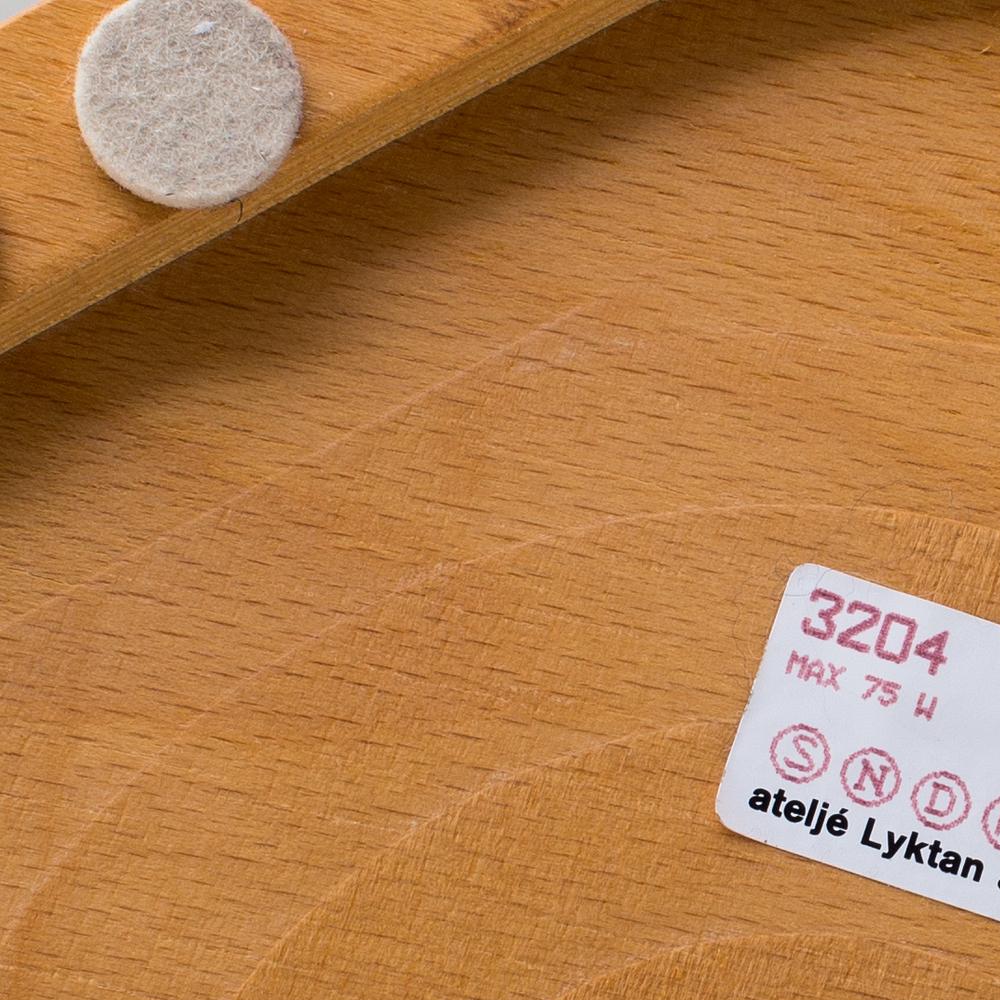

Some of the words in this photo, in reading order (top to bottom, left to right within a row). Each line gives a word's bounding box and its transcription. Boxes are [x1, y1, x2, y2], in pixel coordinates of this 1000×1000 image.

[801, 587, 950, 676] 3204
[785, 649, 848, 692] MAX
[861, 674, 902, 707] 75
[913, 692, 938, 721] W
[748, 788, 849, 837] ateljé
[860, 817, 984, 883] Lyktan
